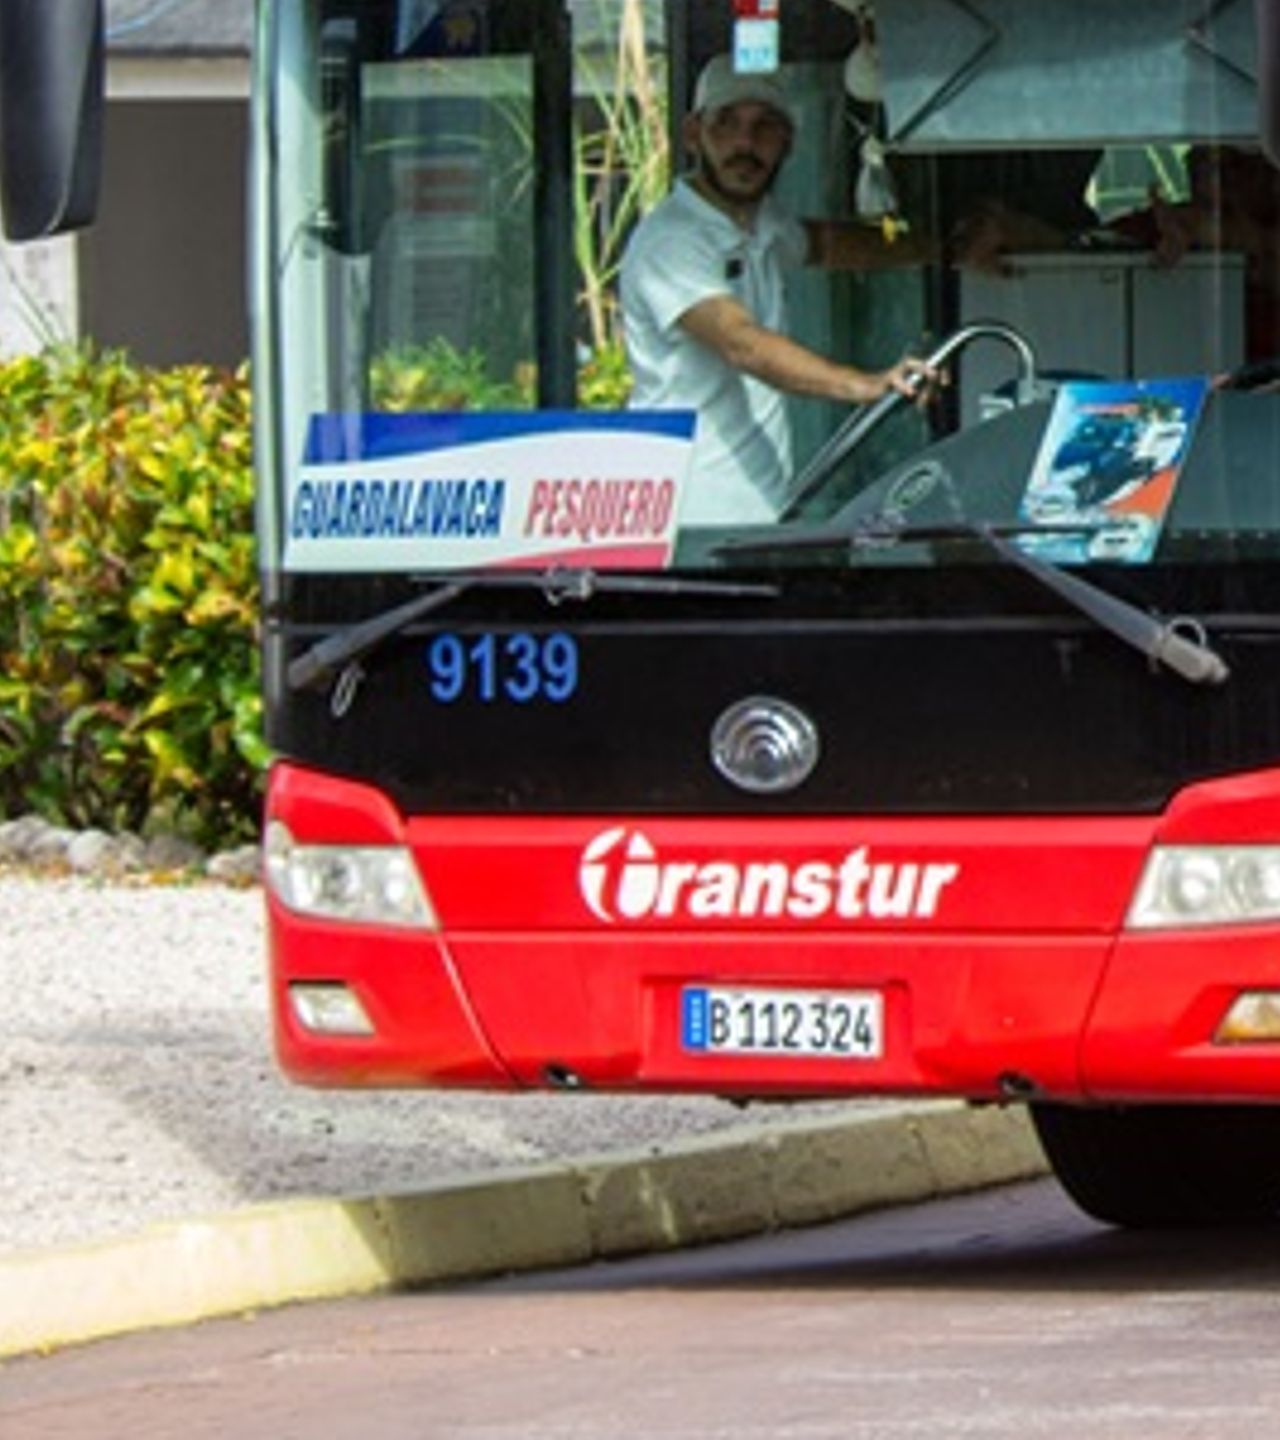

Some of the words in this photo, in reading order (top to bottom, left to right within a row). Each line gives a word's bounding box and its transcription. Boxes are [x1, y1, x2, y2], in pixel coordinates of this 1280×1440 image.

[290, 478, 506, 541] GUARDALAVACA
[525, 478, 676, 541] PESQUERO
[428, 635, 580, 702] 9139
